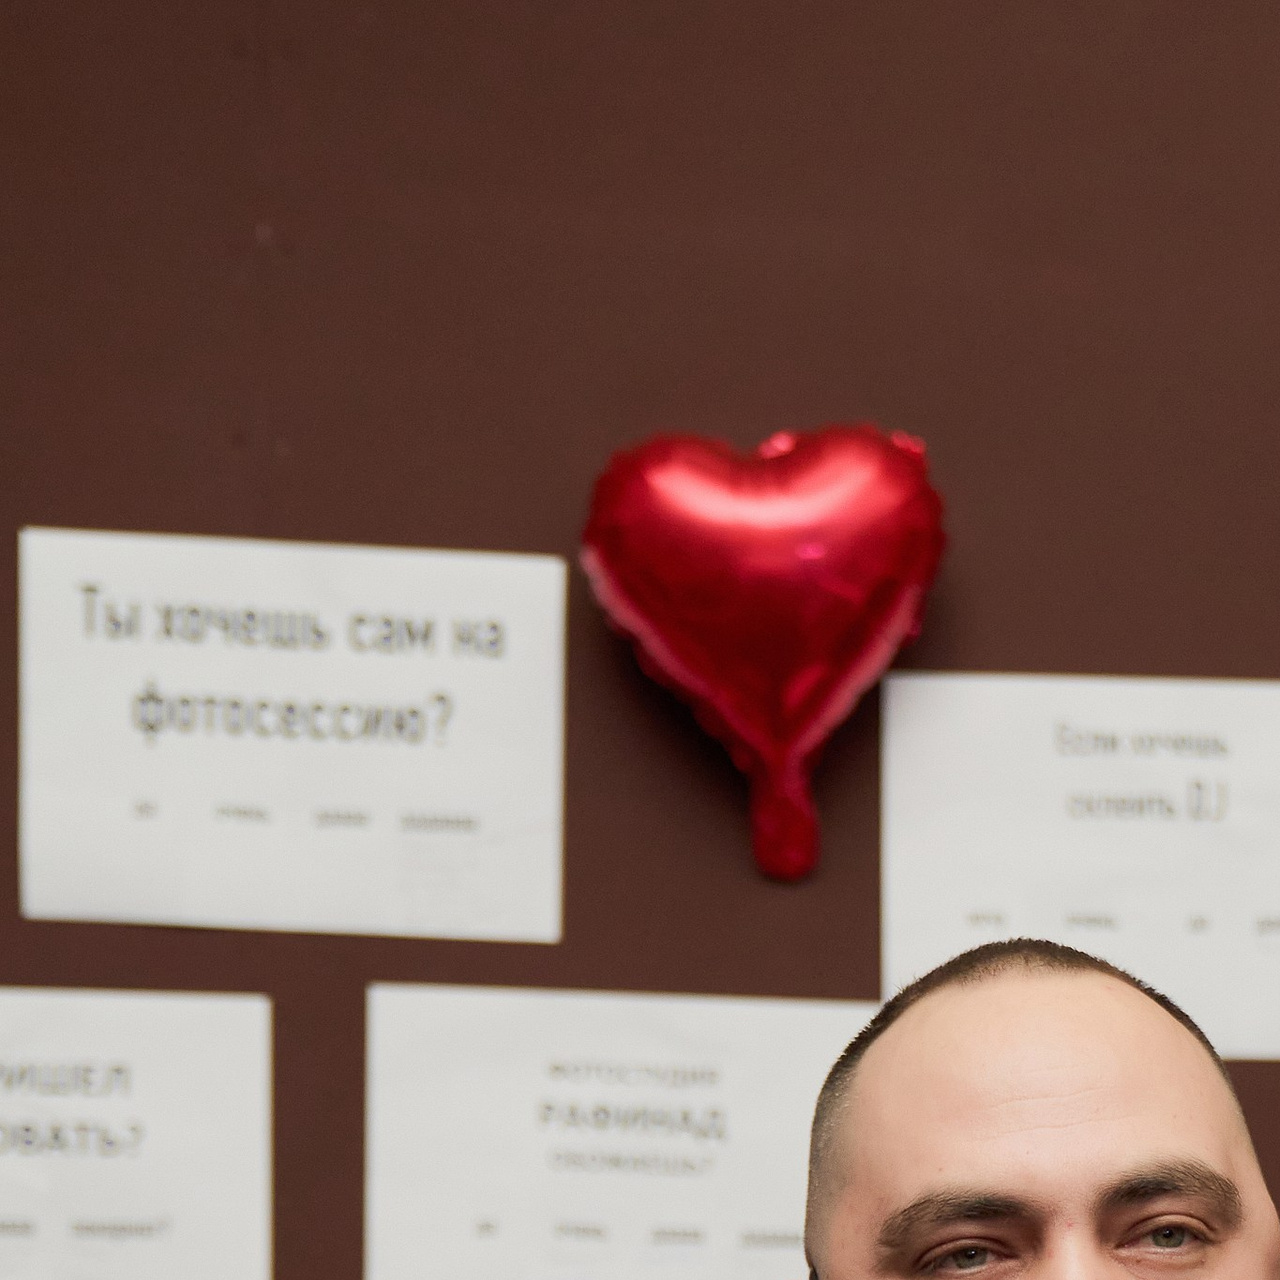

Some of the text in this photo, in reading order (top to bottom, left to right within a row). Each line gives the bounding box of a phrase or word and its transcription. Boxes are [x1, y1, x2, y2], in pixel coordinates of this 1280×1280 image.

[77, 583, 507, 658] Ты хочешь сам на
[132, 677, 454, 746] фотосессию?
